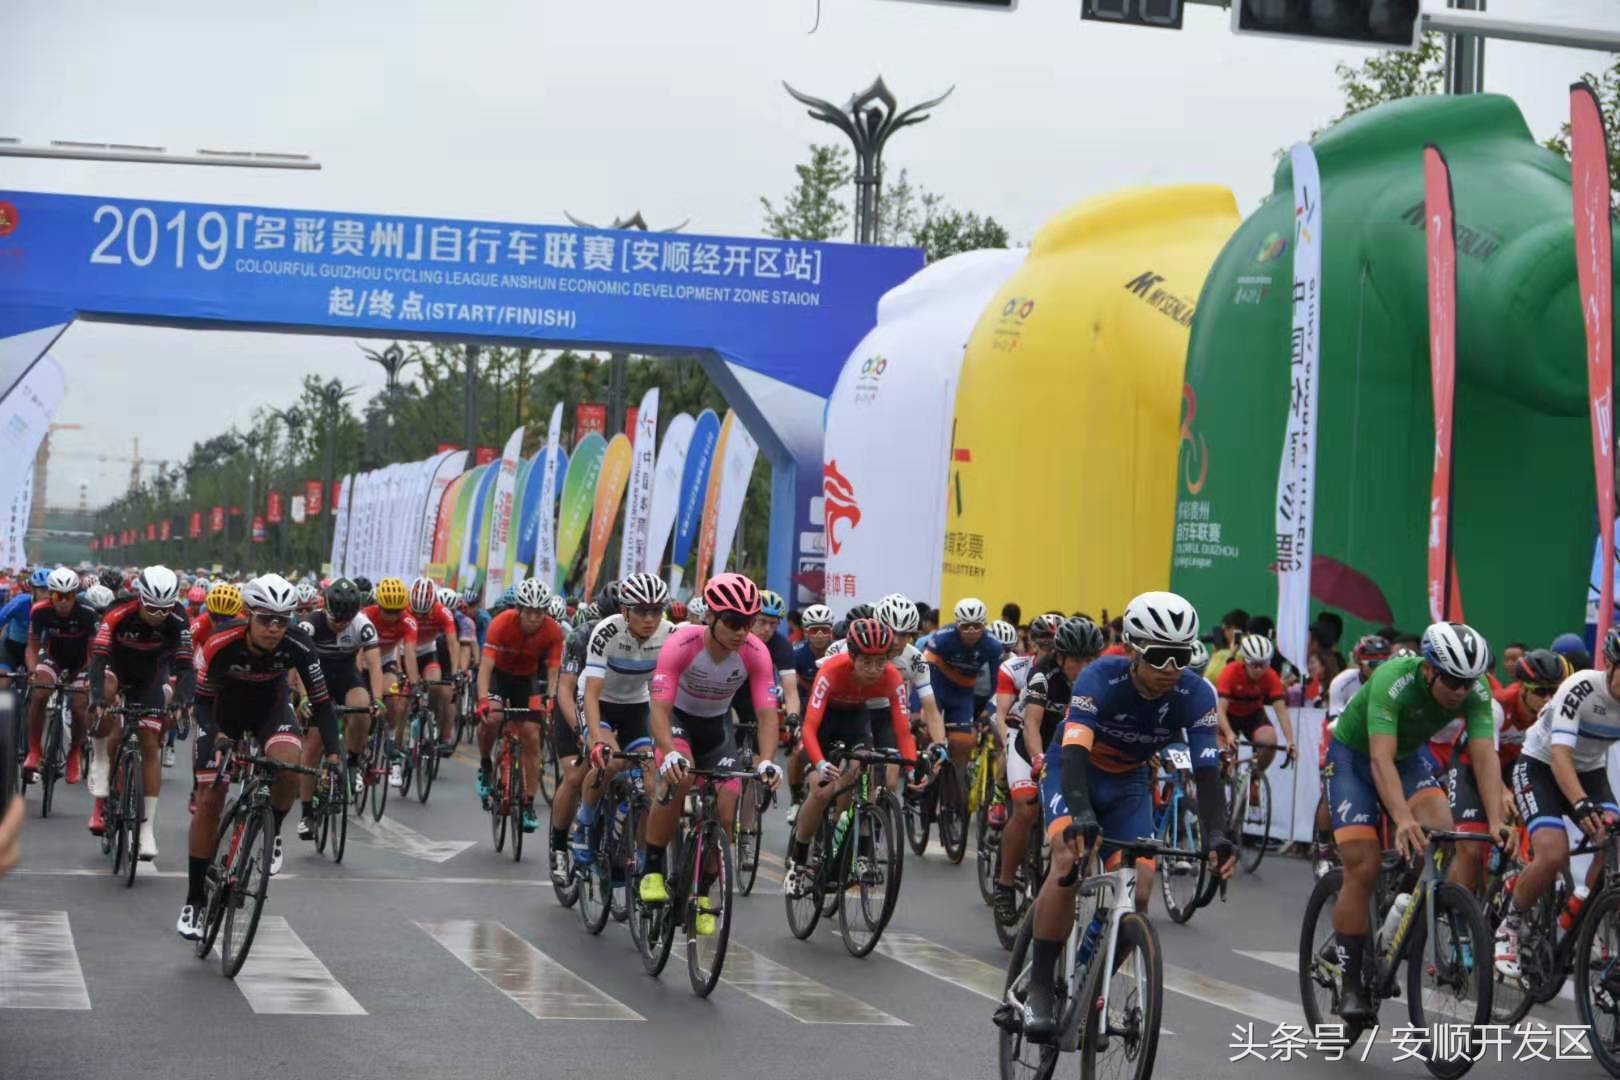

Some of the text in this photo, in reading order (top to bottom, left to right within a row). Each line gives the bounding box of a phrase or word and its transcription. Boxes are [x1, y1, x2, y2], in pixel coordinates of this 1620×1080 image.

[235, 258, 820, 306] COLOURFUL GUIZHOU CYCLING LEAGUE ANSHUN ECONOMIC DEVELOPMENT ZONE STAION
[591, 622, 619, 657] ZERO
[1560, 679, 1594, 720] ZERO
